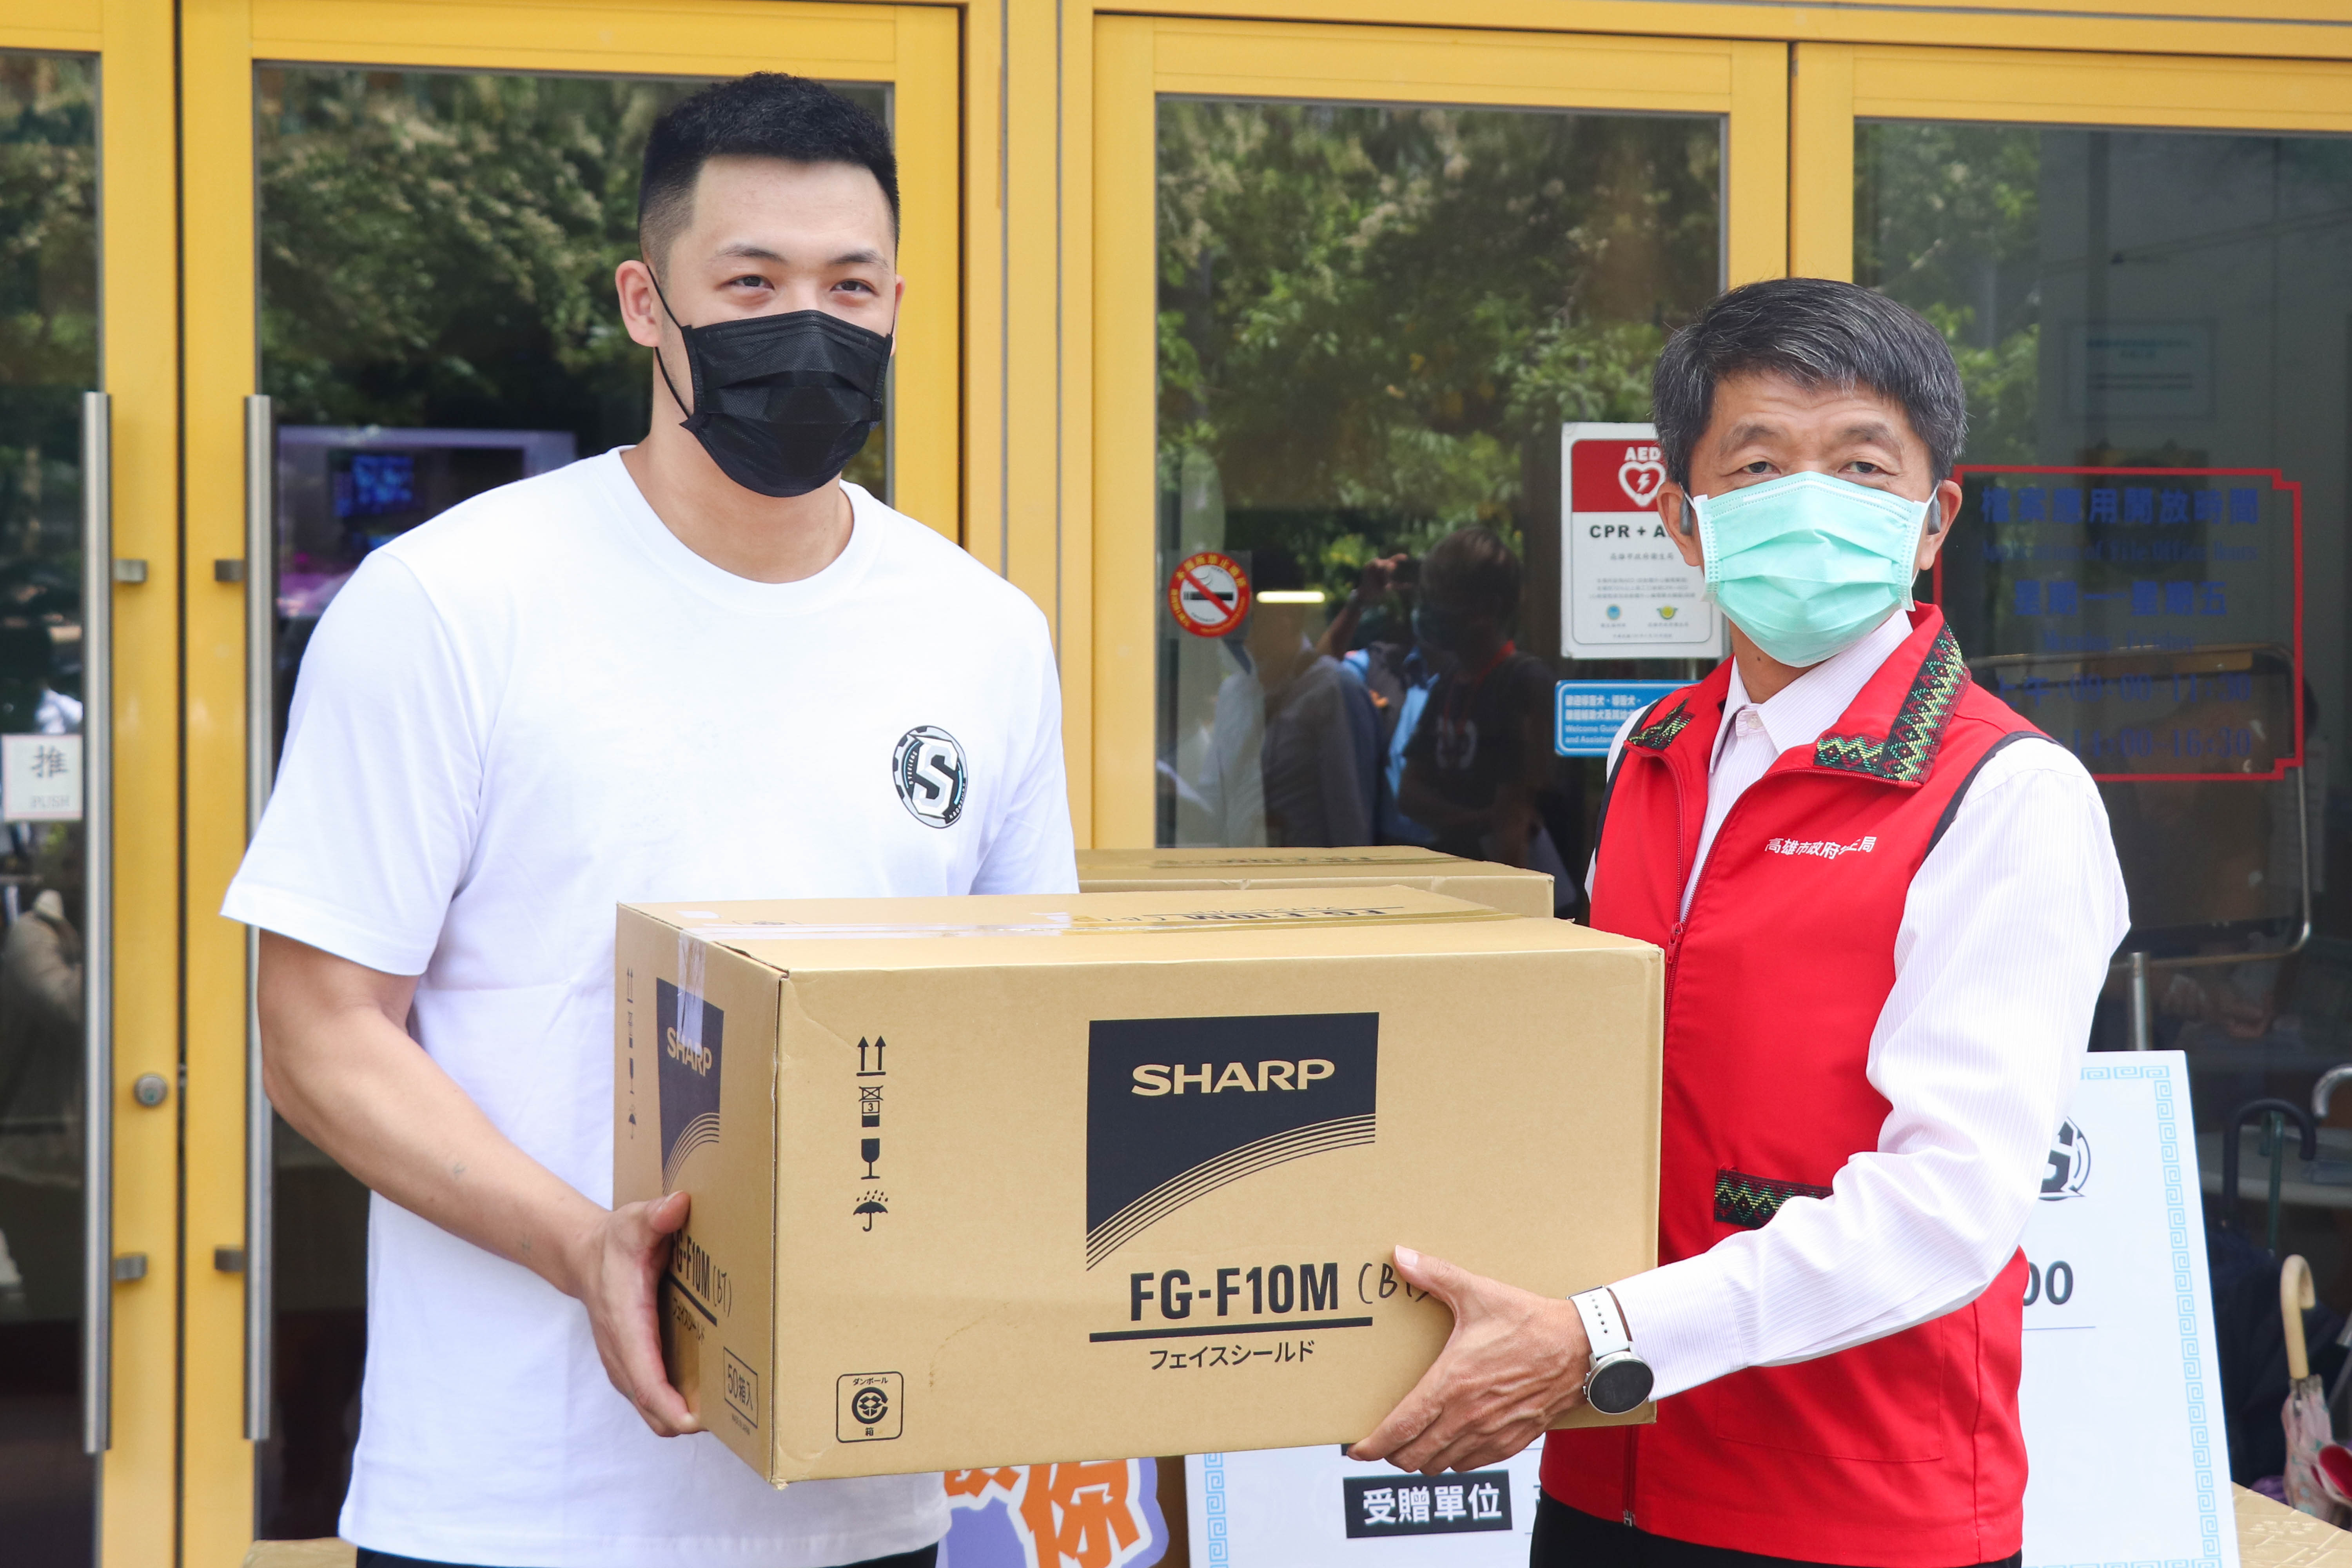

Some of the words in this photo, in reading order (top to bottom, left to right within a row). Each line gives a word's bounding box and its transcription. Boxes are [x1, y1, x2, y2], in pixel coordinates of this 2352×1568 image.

[1624, 446, 1661, 461] AED
[1590, 524, 1630, 538] CPR
[31, 744, 69, 778] 推
[667, 1026, 713, 1077] SHARP
[1131, 1058, 1335, 1096] SHARP
[867, 1102, 874, 1112] 3
[1130, 1262, 1338, 1321] FG-F10M
[1149, 1339, 1315, 1370] フェイスシールド
[728, 1363, 753, 1411] 50箱入
[853, 1377, 889, 1386] ダンボール
[865, 1427, 874, 1436] 箱
[944, 1459, 1140, 1568] 你
[1363, 1483, 1502, 1524] 受贈單位
